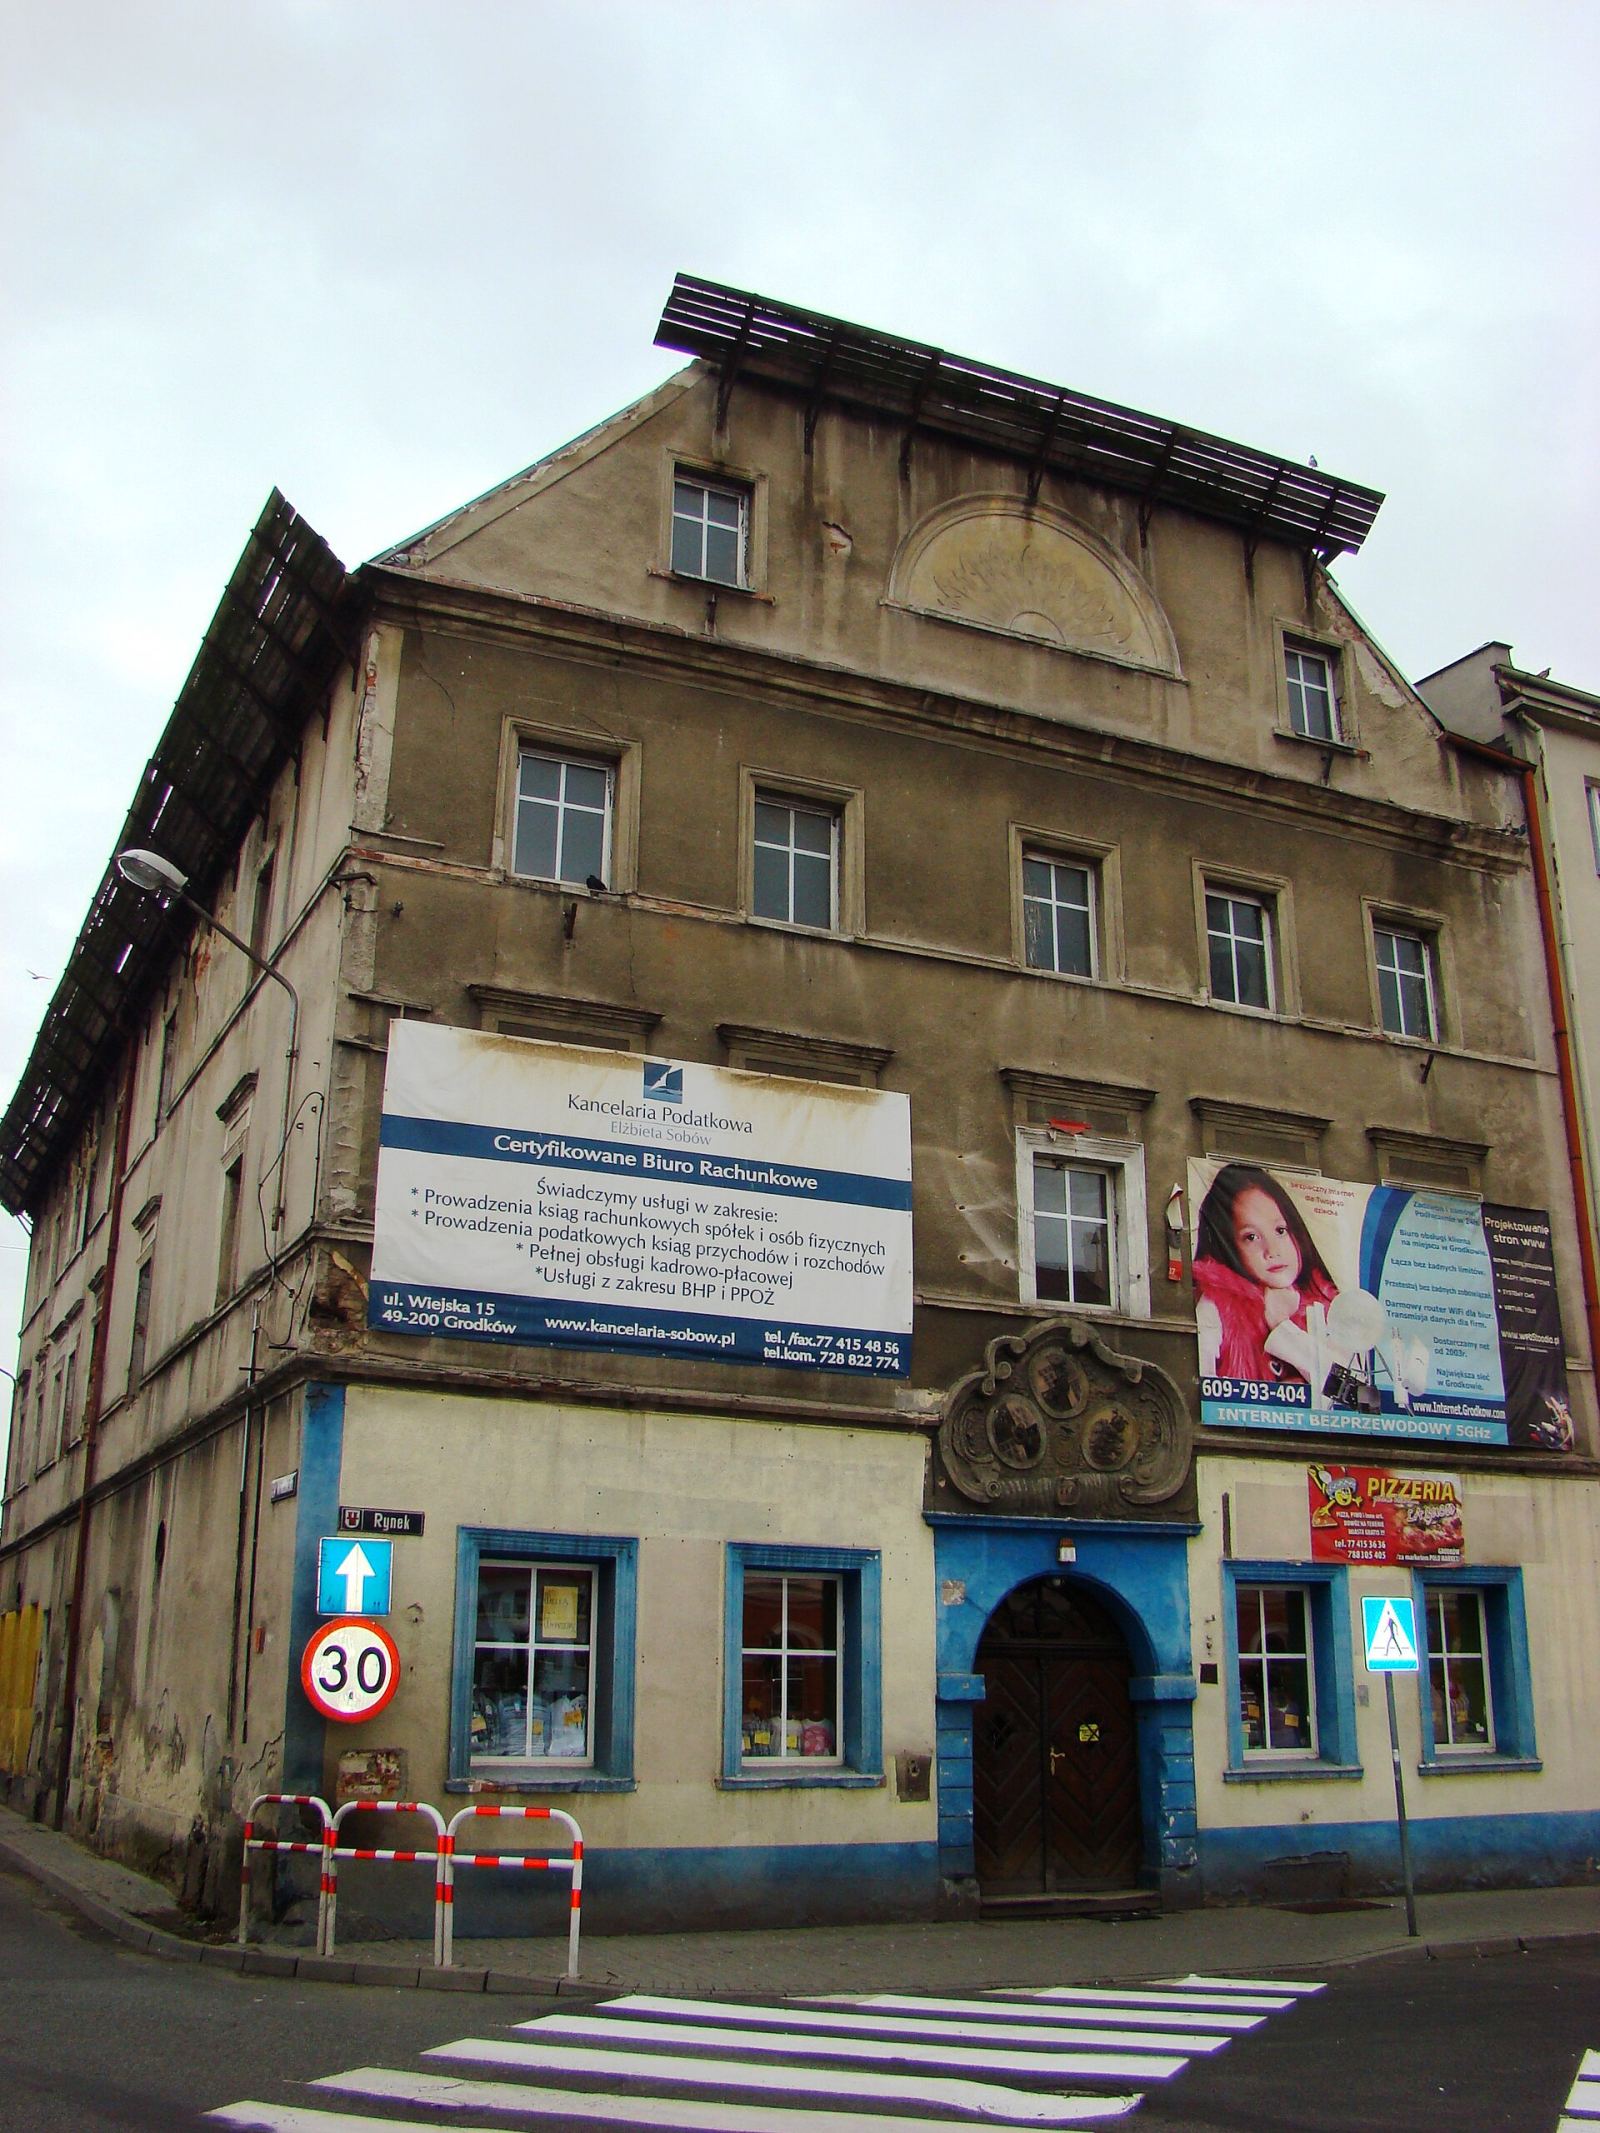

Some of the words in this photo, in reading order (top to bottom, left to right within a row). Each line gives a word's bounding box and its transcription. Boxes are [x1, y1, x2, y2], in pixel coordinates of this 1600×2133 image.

[568, 1094, 656, 1120] Kancelaria
[662, 1107, 752, 1134] Podatkowa
[611, 1120, 662, 1139] Elżbieta
[666, 1128, 711, 1145] Sobów
[494, 1134, 637, 1167] Certyfikowane
[643, 1153, 694, 1174] Biuro
[700, 1161, 818, 1190] Rachunkowe
[537, 1177, 637, 1209] Świadczymy
[643, 1194, 689, 1214] usługi
[695, 1203, 708, 1213] w
[714, 1203, 778, 1222] zakresie:
[425, 1188, 532, 1215] Prowadzenia
[539, 1201, 578, 1223] ksiąg
[584, 1208, 699, 1235] rachunkowych
[705, 1223, 754, 1241] spółek
[760, 1228, 764, 1241] i
[769, 1231, 803, 1247] osób
[809, 1233, 886, 1256] fizycznych
[425, 1210, 532, 1236] Prowadzenia
[539, 1225, 645, 1251] podatkowych
[652, 1236, 690, 1257] ksiąg
[696, 1244, 788, 1265] przychodów
[794, 1253, 798, 1266] i
[804, 1256, 885, 1276] rozchodów
[1493, 1234, 1519, 1245] stron
[1520, 1238, 1545, 1249] www
[530, 1243, 580, 1266] Pełnej
[586, 1250, 644, 1273] obsługi
[651, 1256, 792, 1289] kadrowo-płacowej
[601, 1278, 610, 1288] z
[616, 1277, 675, 1295] zakresu
[682, 1282, 716, 1298] BHP
[721, 1286, 725, 1300] i
[731, 1286, 775, 1305] PPOŻ
[383, 1293, 403, 1306] ul.
[409, 1294, 470, 1314] Wiejska
[476, 1302, 495, 1316] 15
[1385, 1300, 1422, 1311] Darmowy
[382, 1310, 439, 1326] 49-200
[444, 1316, 516, 1334] Grodków
[545, 1318, 735, 1347] www.kancelaria-sobow.pl
[764, 1331, 785, 1344] tel.
[836, 1338, 860, 1351] 415
[864, 1341, 881, 1353] 48
[885, 1342, 899, 1354] 56
[764, 1346, 815, 1363] tel.kom.
[820, 1351, 845, 1365] 728
[848, 1355, 872, 1368] 822
[876, 1357, 900, 1370] 774
[1202, 1382, 1306, 1403] 609-793-404
[1218, 1407, 1304, 1425] INTERNET
[1309, 1414, 1451, 1436] BEZPRZEWODOWY
[1455, 1425, 1491, 1439] 5GHz
[1368, 1478, 1453, 1500] PIZZERIA
[374, 1513, 410, 1531] Rynek
[319, 1645, 387, 1693] 30
